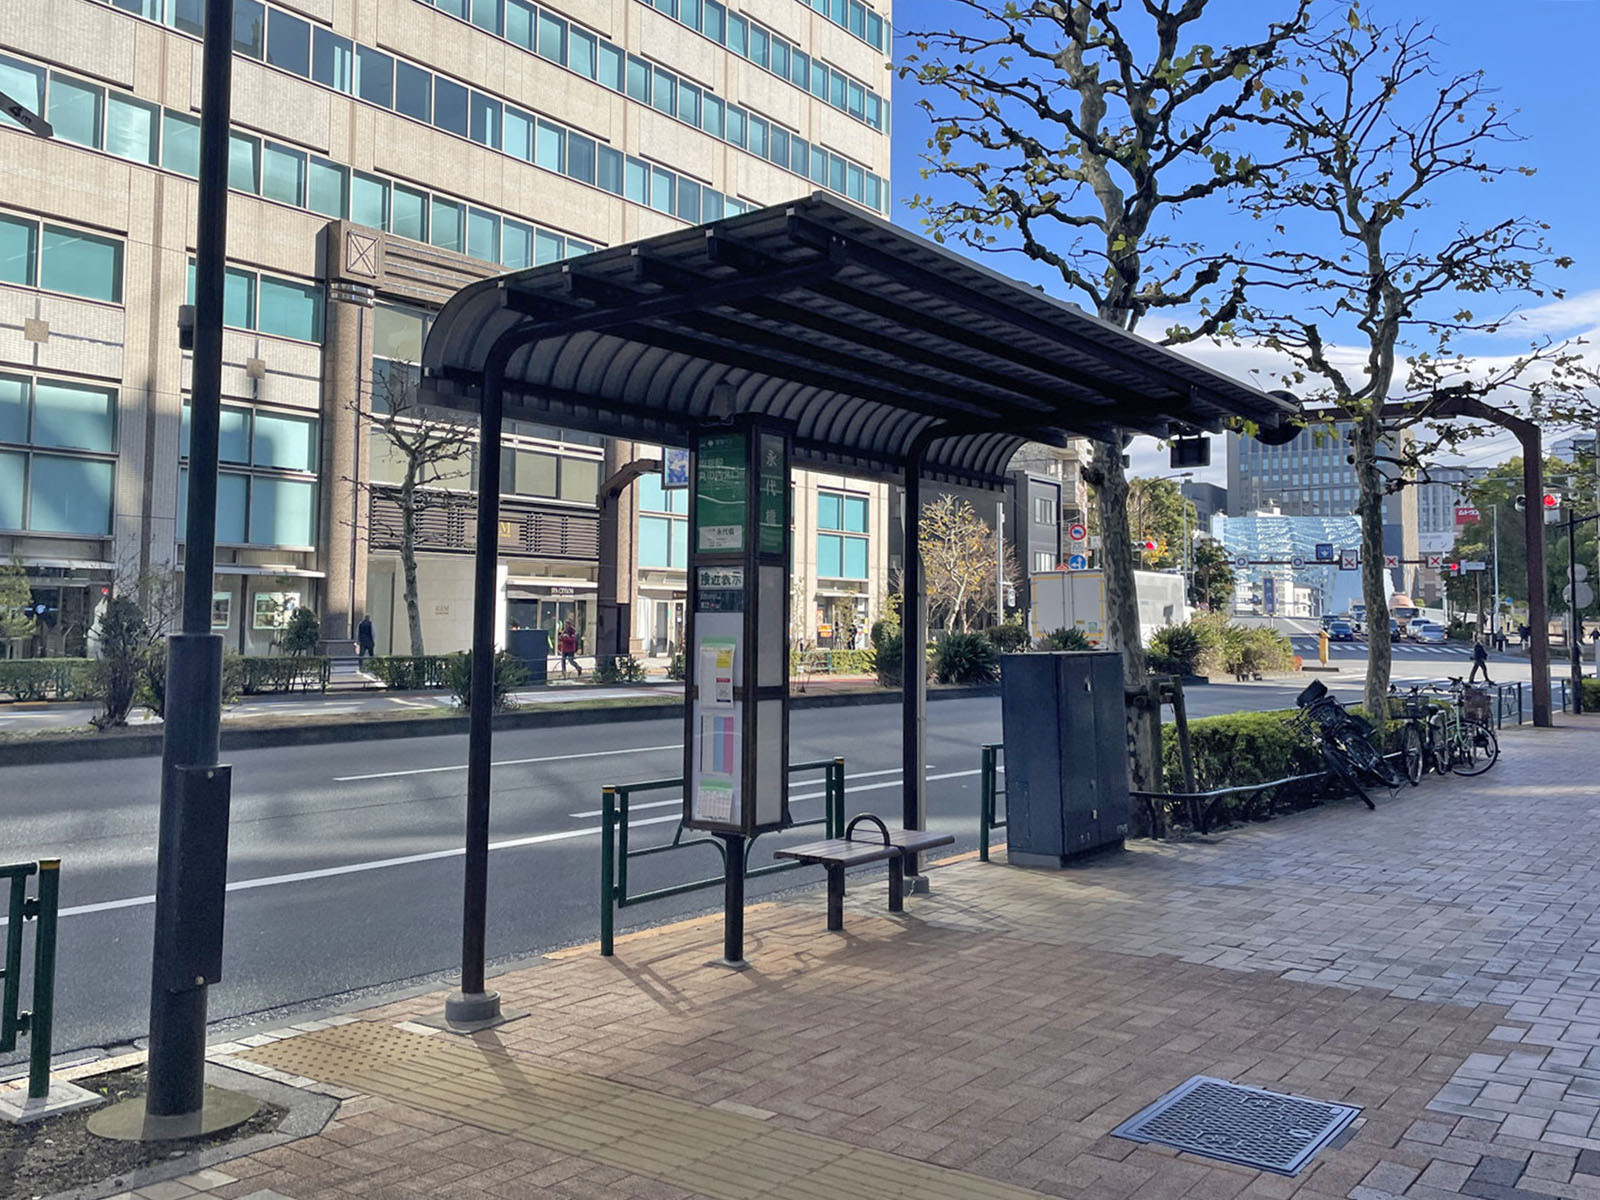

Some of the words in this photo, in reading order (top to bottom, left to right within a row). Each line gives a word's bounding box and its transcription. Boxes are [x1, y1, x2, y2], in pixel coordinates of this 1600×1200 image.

[766, 449, 777, 524] 永代橋
[700, 571, 742, 586] 接近表示
